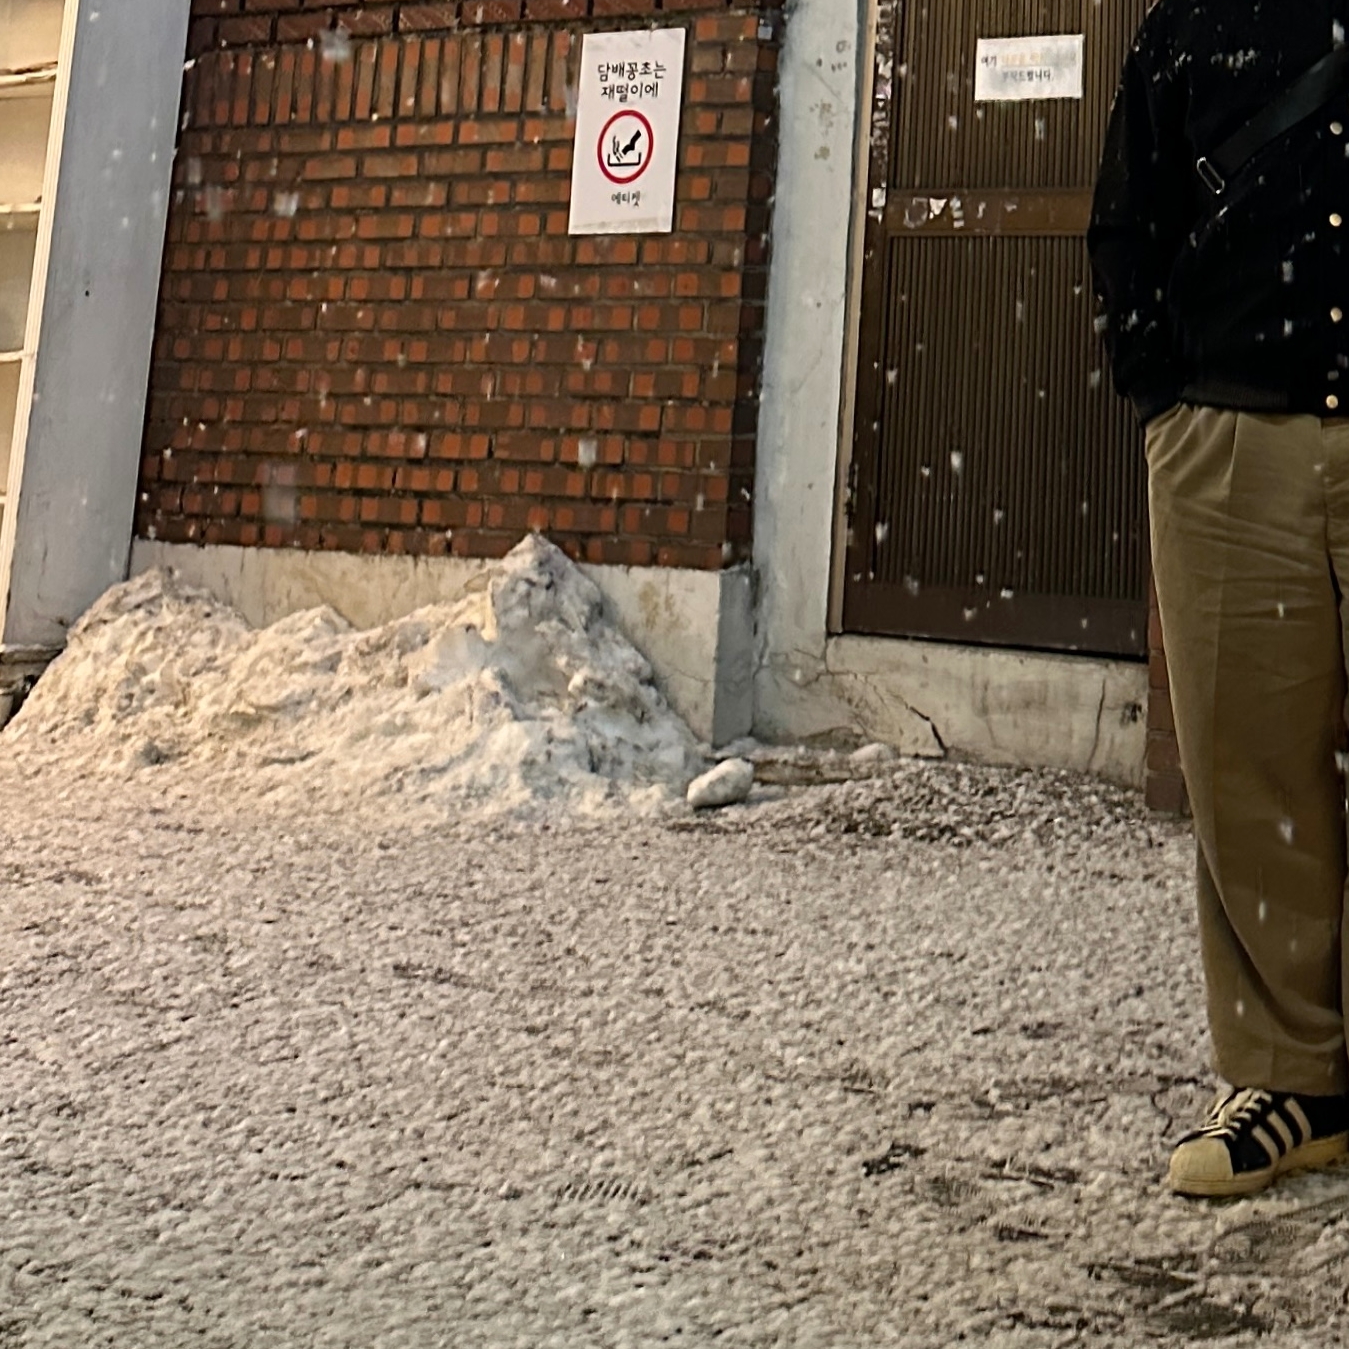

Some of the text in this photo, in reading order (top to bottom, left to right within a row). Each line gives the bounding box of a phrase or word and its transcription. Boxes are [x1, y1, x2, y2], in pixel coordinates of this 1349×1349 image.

[597, 60, 667, 83] 담배꽁초는
[600, 81, 659, 103] 재떨이에
[611, 190, 641, 207] 에티켓
